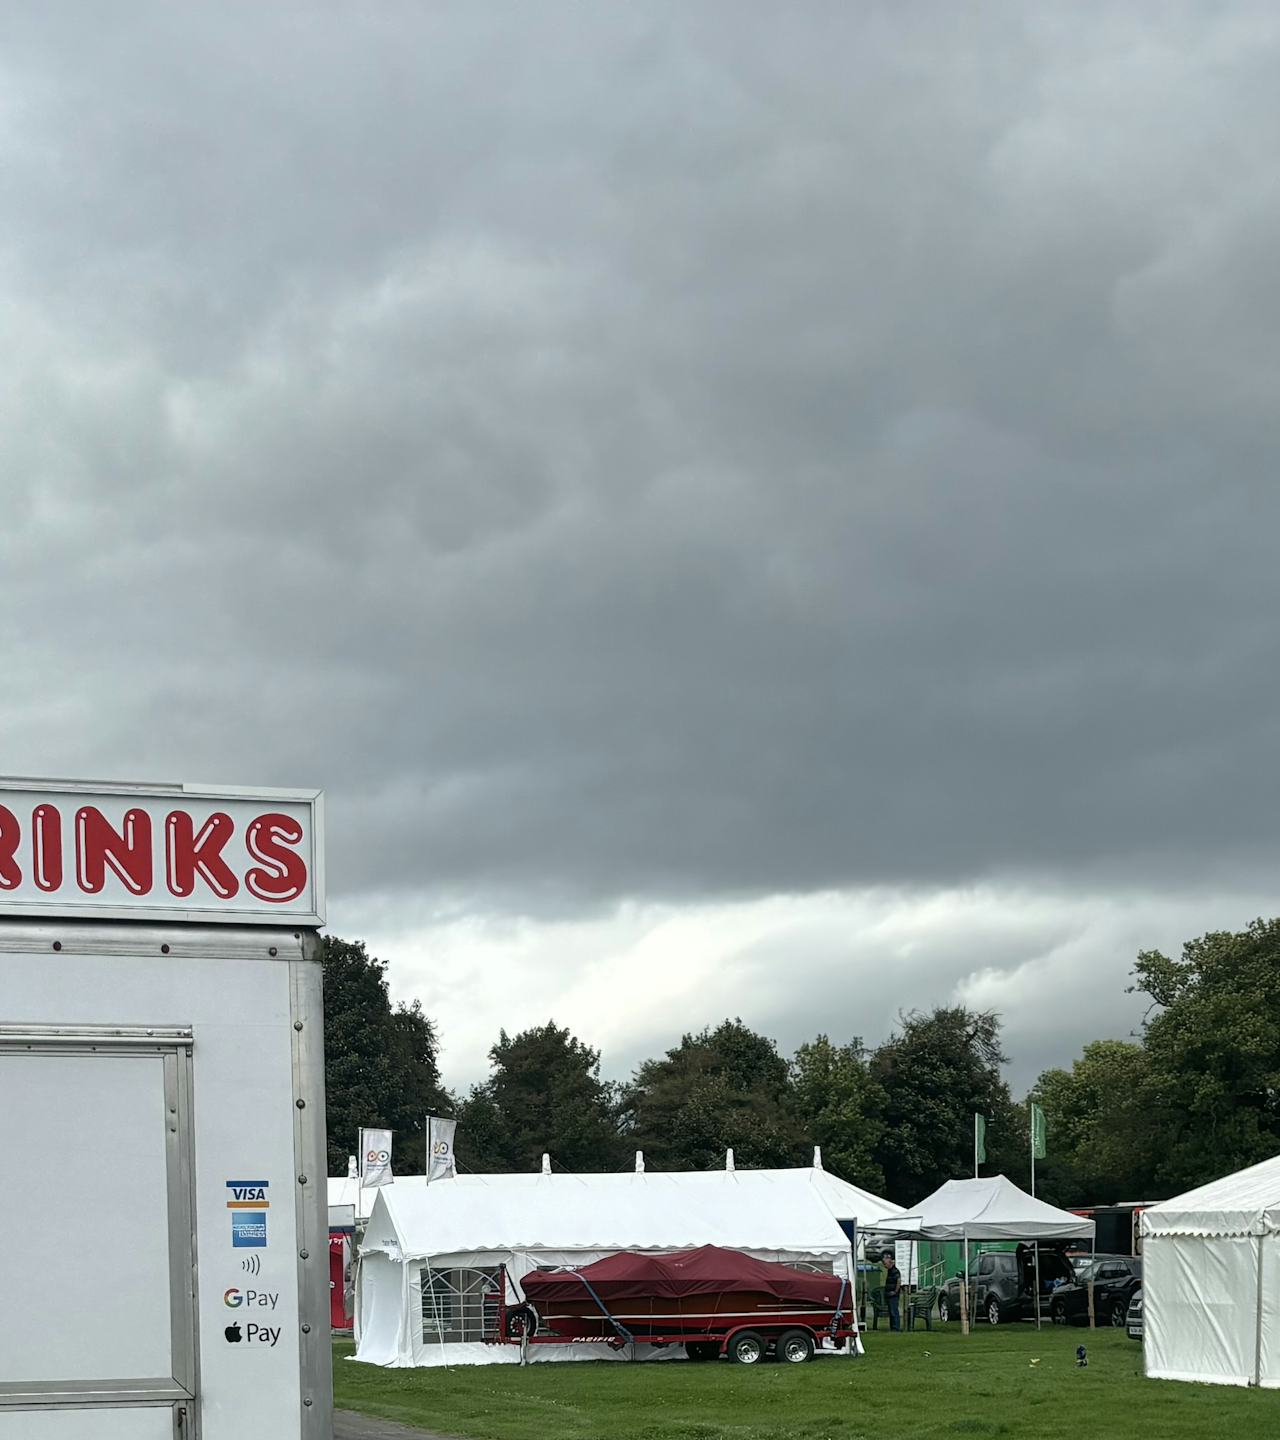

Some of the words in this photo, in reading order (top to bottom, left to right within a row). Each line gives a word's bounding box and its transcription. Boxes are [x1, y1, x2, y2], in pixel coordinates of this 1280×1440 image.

[232, 1188, 266, 1201] VISA
[246, 1290, 279, 1310] Pay
[246, 1323, 281, 1347] Pay
